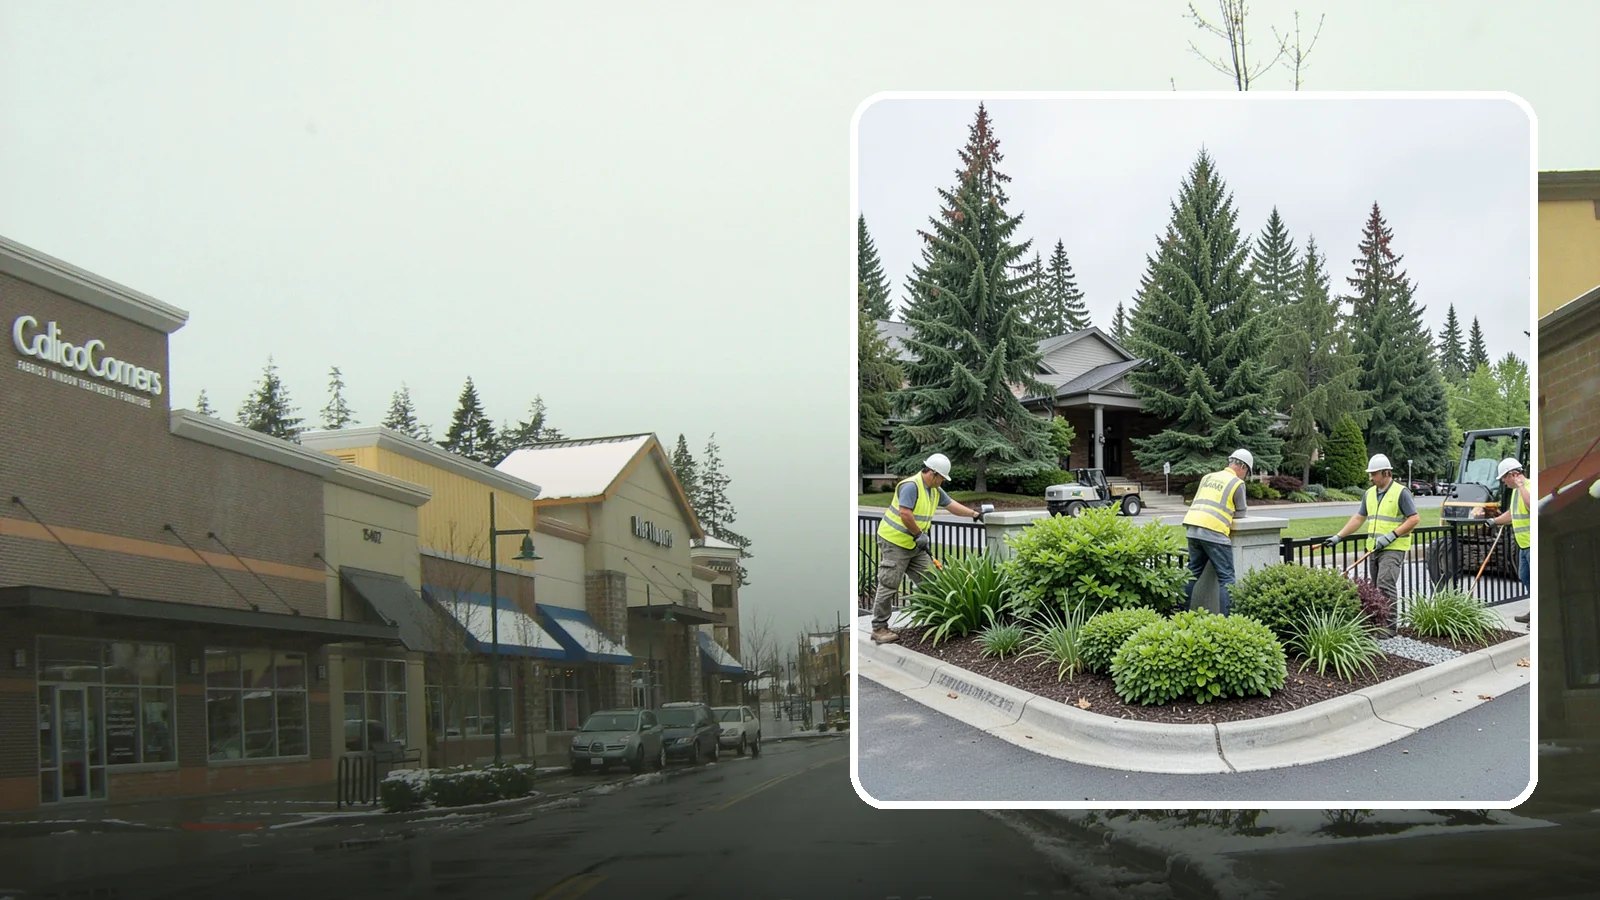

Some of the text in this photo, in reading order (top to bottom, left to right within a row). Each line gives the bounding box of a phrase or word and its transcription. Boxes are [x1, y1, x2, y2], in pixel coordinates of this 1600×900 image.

[13, 315, 162, 395] CalicoCorners
[16, 360, 47, 377] FABRICS
[51, 370, 78, 387] WINDOW
[78, 378, 116, 398] TREATMENTS
[120, 391, 151, 409] FURNITURE
